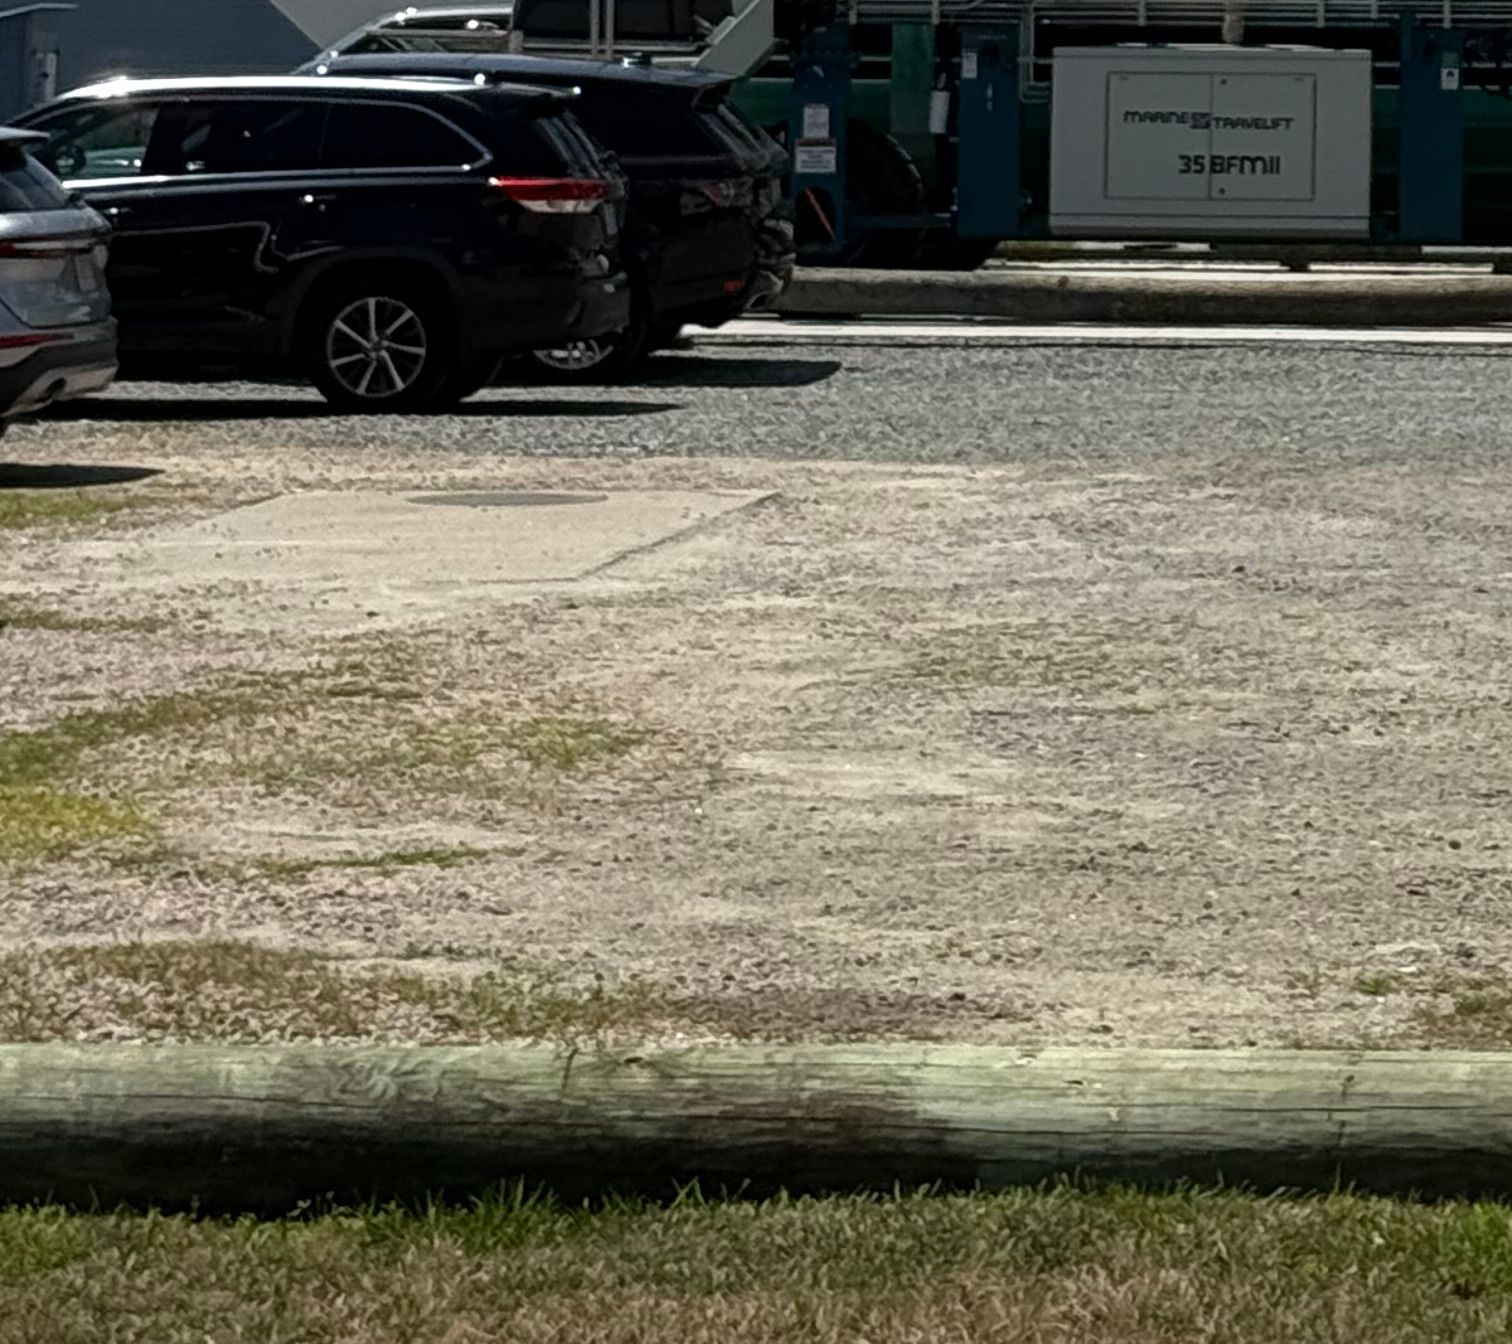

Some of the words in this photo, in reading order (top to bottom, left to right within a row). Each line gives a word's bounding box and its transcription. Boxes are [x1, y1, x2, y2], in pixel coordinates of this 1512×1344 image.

[1123, 110, 1188, 124] MARINE
[1214, 116, 1294, 130] TRAVELIFT
[1178, 154, 1205, 175] 35
